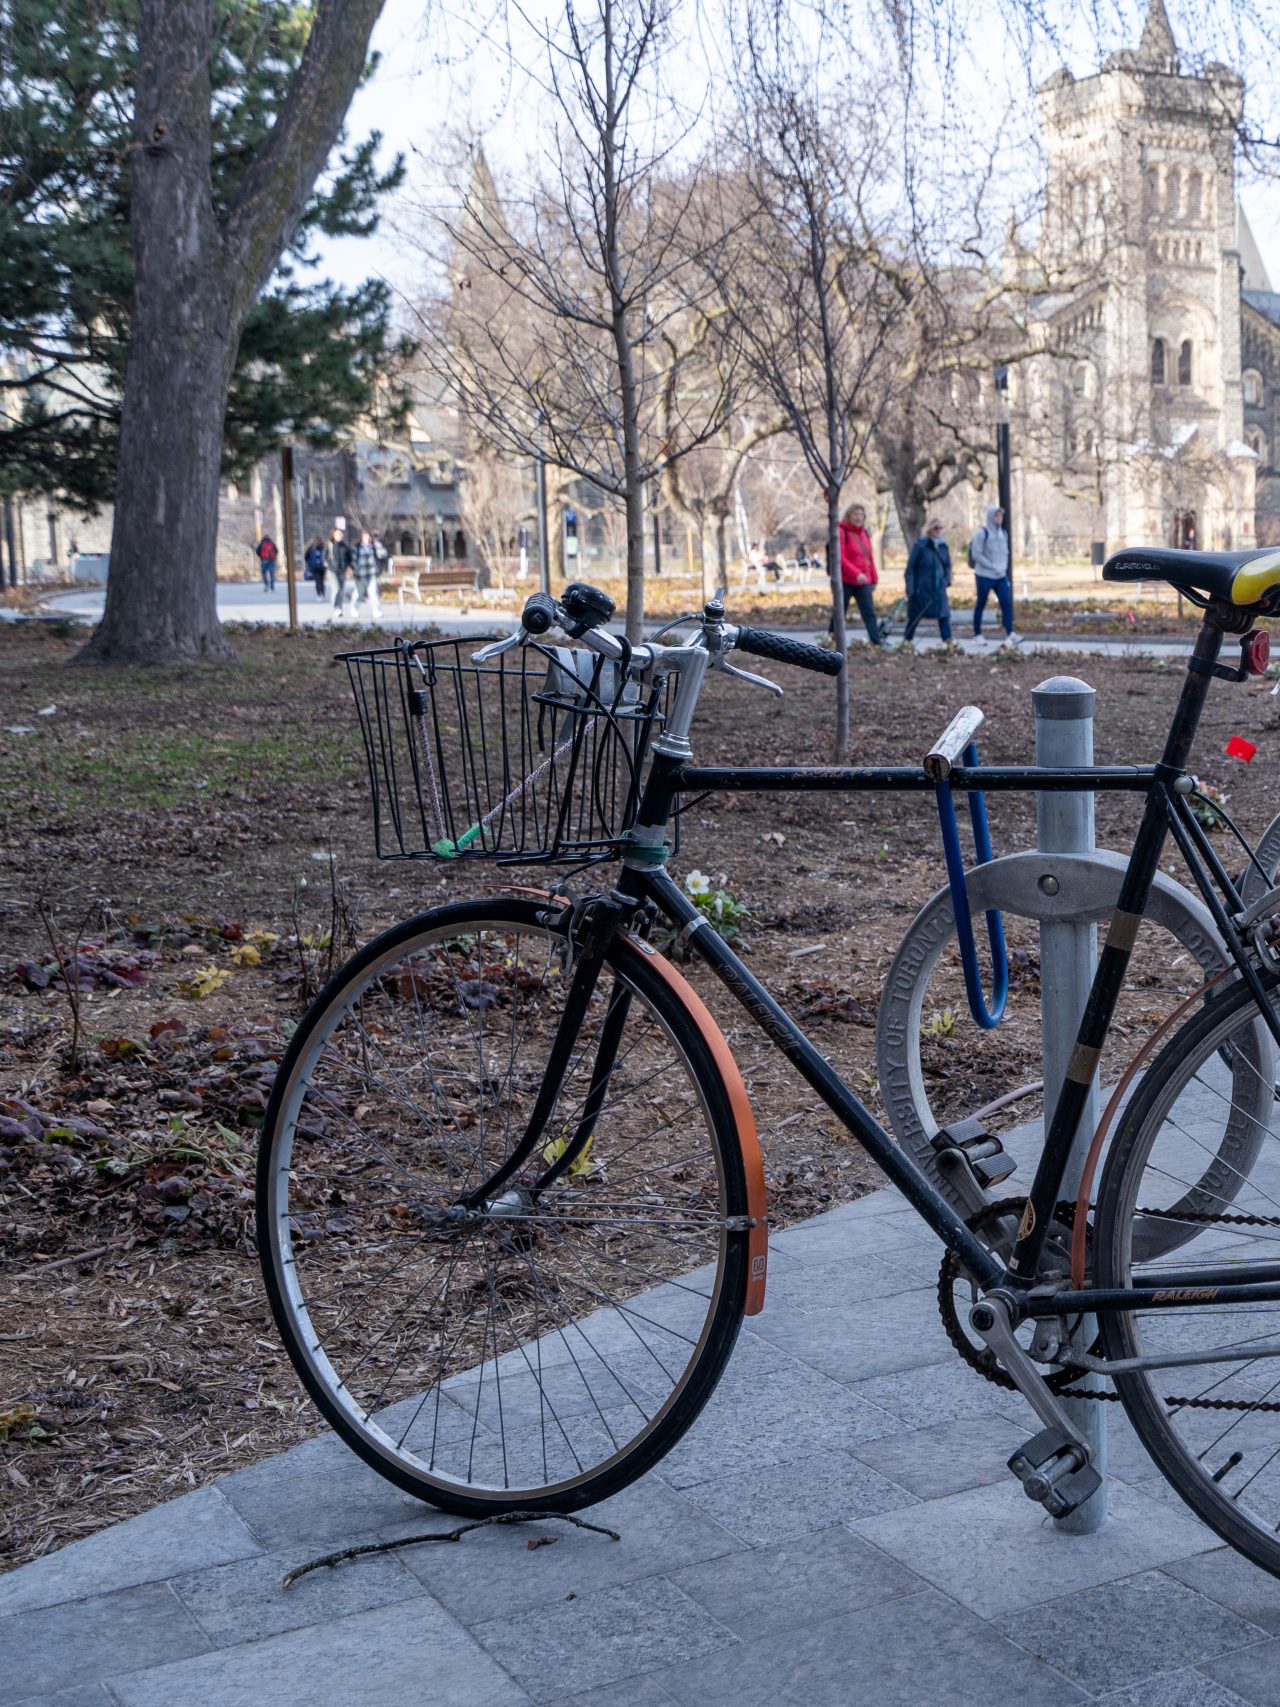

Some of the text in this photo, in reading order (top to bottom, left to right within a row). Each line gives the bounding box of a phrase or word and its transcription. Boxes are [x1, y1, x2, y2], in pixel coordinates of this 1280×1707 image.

[893, 906, 956, 1001] TORONTO
[714, 961, 801, 1051] RALEIGH
[886, 1013, 906, 1047] OF
[1151, 1288, 1219, 1302] RALEIGH
